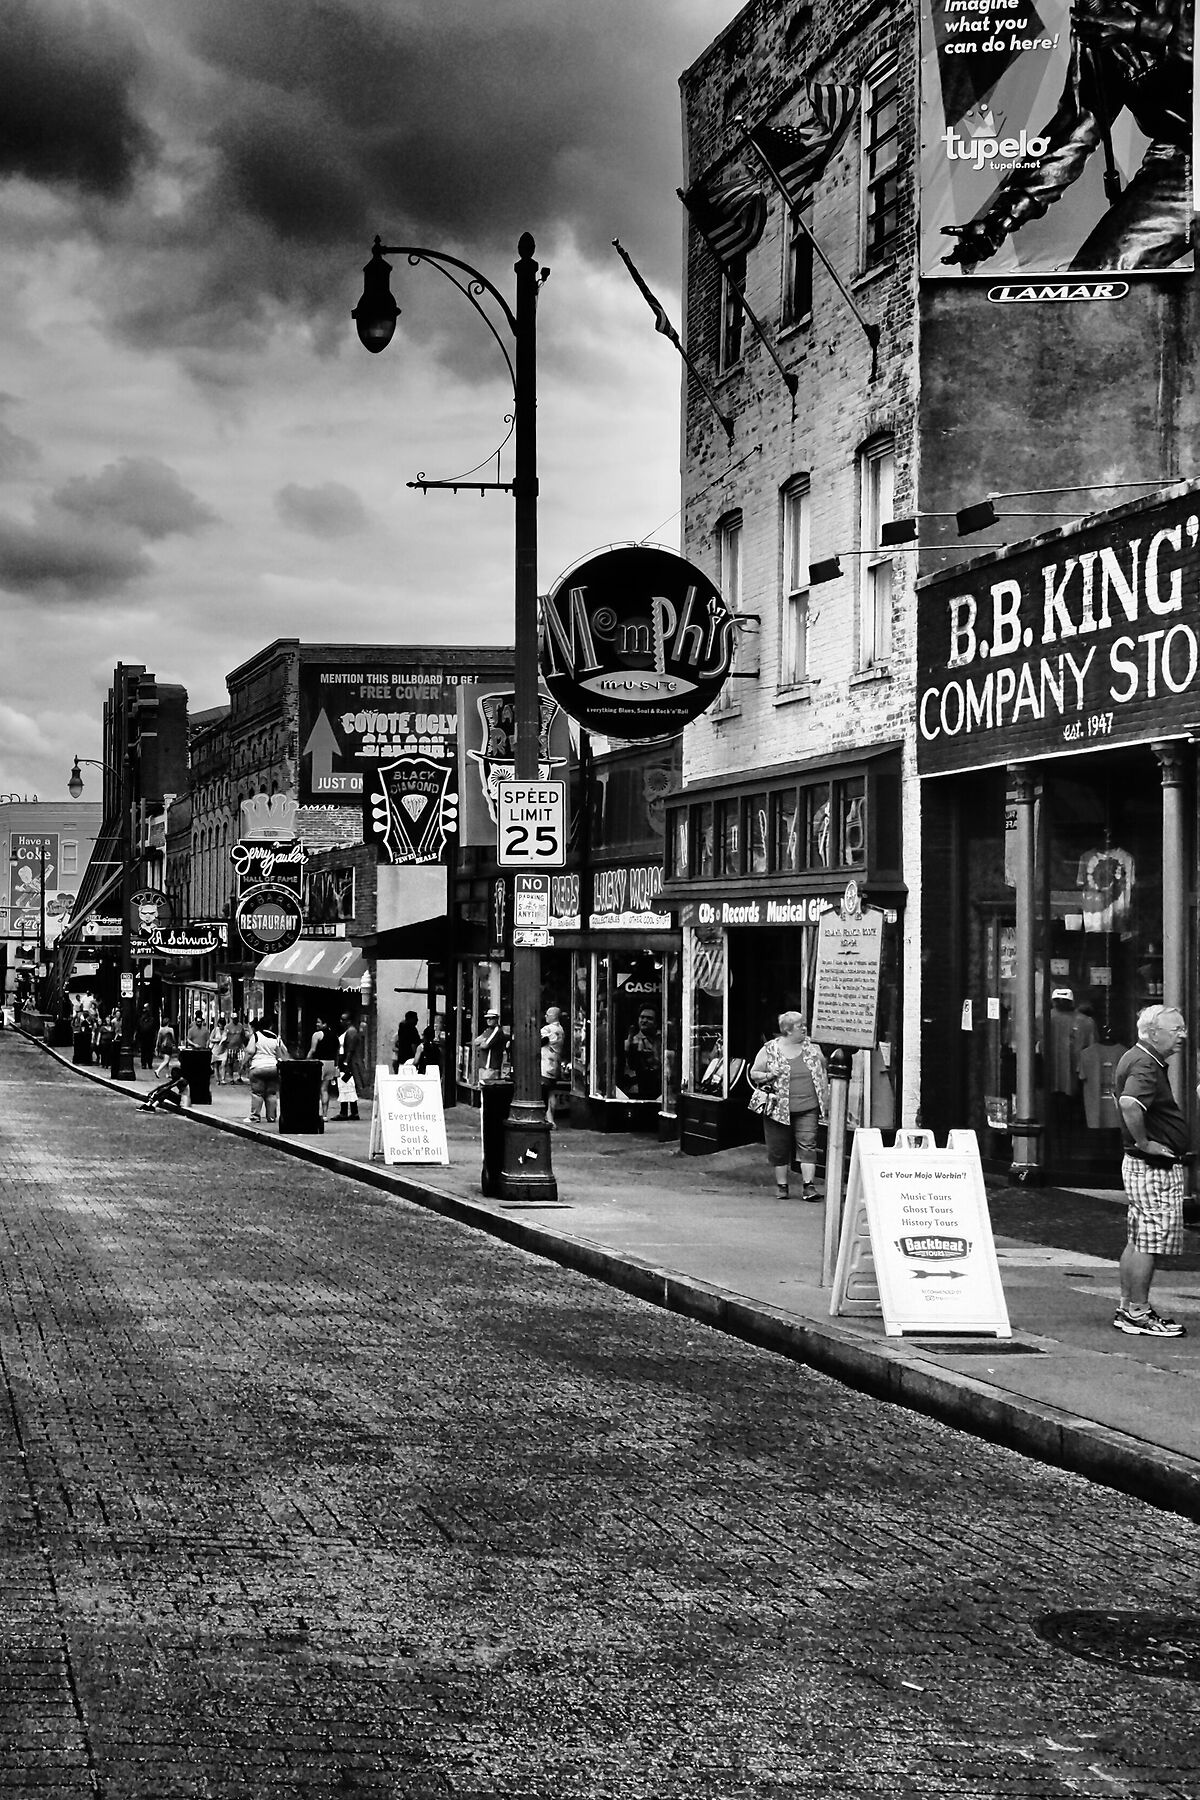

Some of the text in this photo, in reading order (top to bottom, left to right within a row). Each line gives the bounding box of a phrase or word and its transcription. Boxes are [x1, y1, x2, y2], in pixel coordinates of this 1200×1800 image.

[945, 15, 1028, 35] what you
[944, 33, 1060, 54] can do here!
[941, 126, 1052, 170] tupelo
[990, 160, 1041, 171] tupelo.net
[1000, 284, 1115, 300] LAMAR
[945, 579, 1033, 670] B.B.
[320, 673, 364, 684] MENTION
[366, 674, 389, 684] THIS
[391, 674, 443, 685] BILLBOARD
[446, 675, 458, 685] TO
[919, 623, 1198, 741] COMPANY STO
[359, 685, 439, 700] FREE COVER
[340, 711, 458, 735] COYOTE UGLY
[1063, 712, 1114, 741] est. 1947
[393, 771, 436, 780] BLACK
[318, 777, 347, 790] JUST
[390, 780, 440, 794] DIAMOND
[504, 791, 559, 804] SPEED
[510, 808, 552, 821] LIMIT
[18, 835, 51, 846] Have a
[505, 825, 559, 856] 25
[16, 846, 52, 860] Coke
[231, 845, 272, 875] Jerry
[243, 875, 299, 883] HALL OF FAME
[522, 878, 542, 890] NO
[593, 868, 627, 913] LUCKY
[518, 894, 545, 902] PARKING
[699, 903, 715, 924] CDs
[722, 901, 760, 924] Records
[766, 899, 807, 922] Musical
[240, 913, 298, 931] RESTAURANT
[167, 930, 218, 946] Schwab
[625, 981, 662, 993] CASH
[388, 1112, 437, 1122] Everything
[400, 1124, 428, 1133] Blues,
[401, 1135, 430, 1144] Soul &
[880, 1171, 893, 1179] Get
[895, 1171, 912, 1179] Your
[914, 1171, 933, 1180] Mojo
[900, 1192, 952, 1201] Music Tours
[902, 1205, 954, 1214] Ghost Tours
[901, 1218, 958, 1229] History Tours
[905, 1238, 965, 1252] Backbeat
